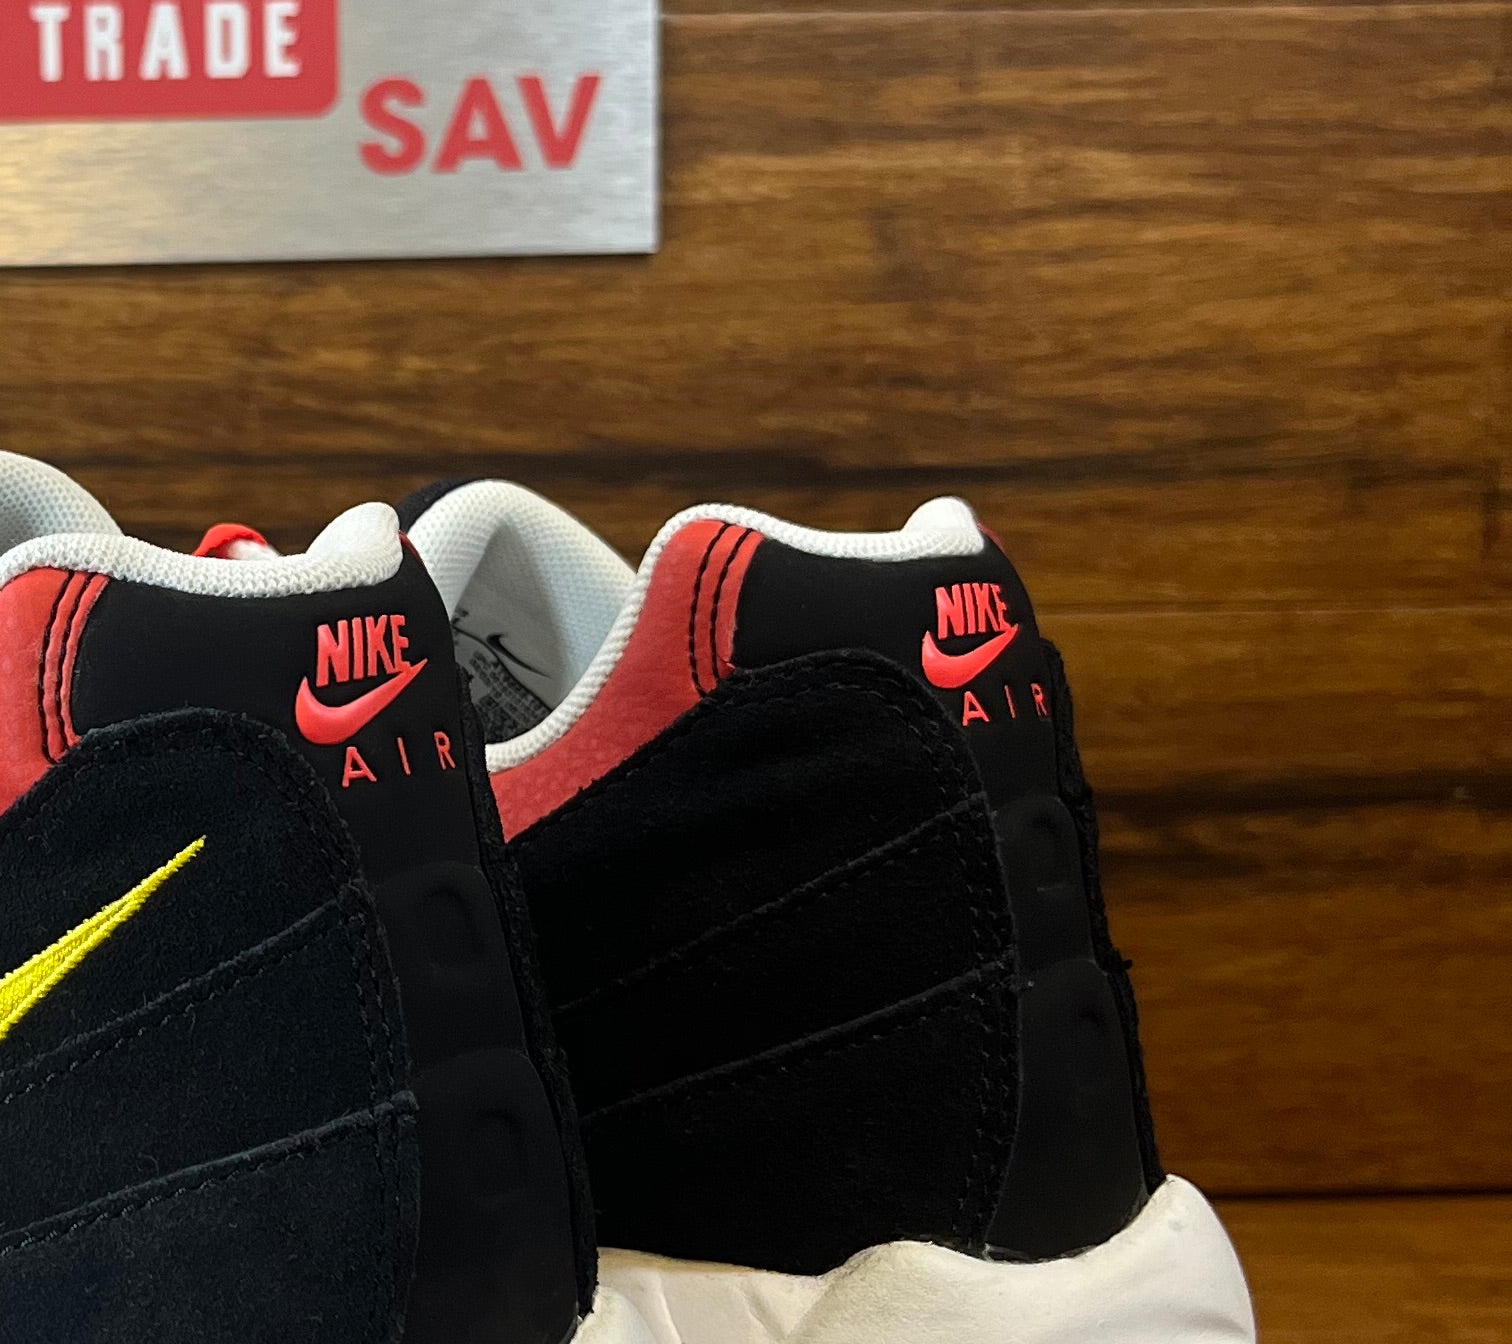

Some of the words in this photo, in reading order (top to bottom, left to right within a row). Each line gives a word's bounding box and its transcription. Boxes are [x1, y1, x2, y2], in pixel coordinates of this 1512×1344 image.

[358, 72, 601, 176] SAV
[934, 581, 1013, 641] NIKE
[315, 614, 411, 688] NIKE
[961, 682, 1048, 727] AIR
[341, 730, 457, 788] AIR
